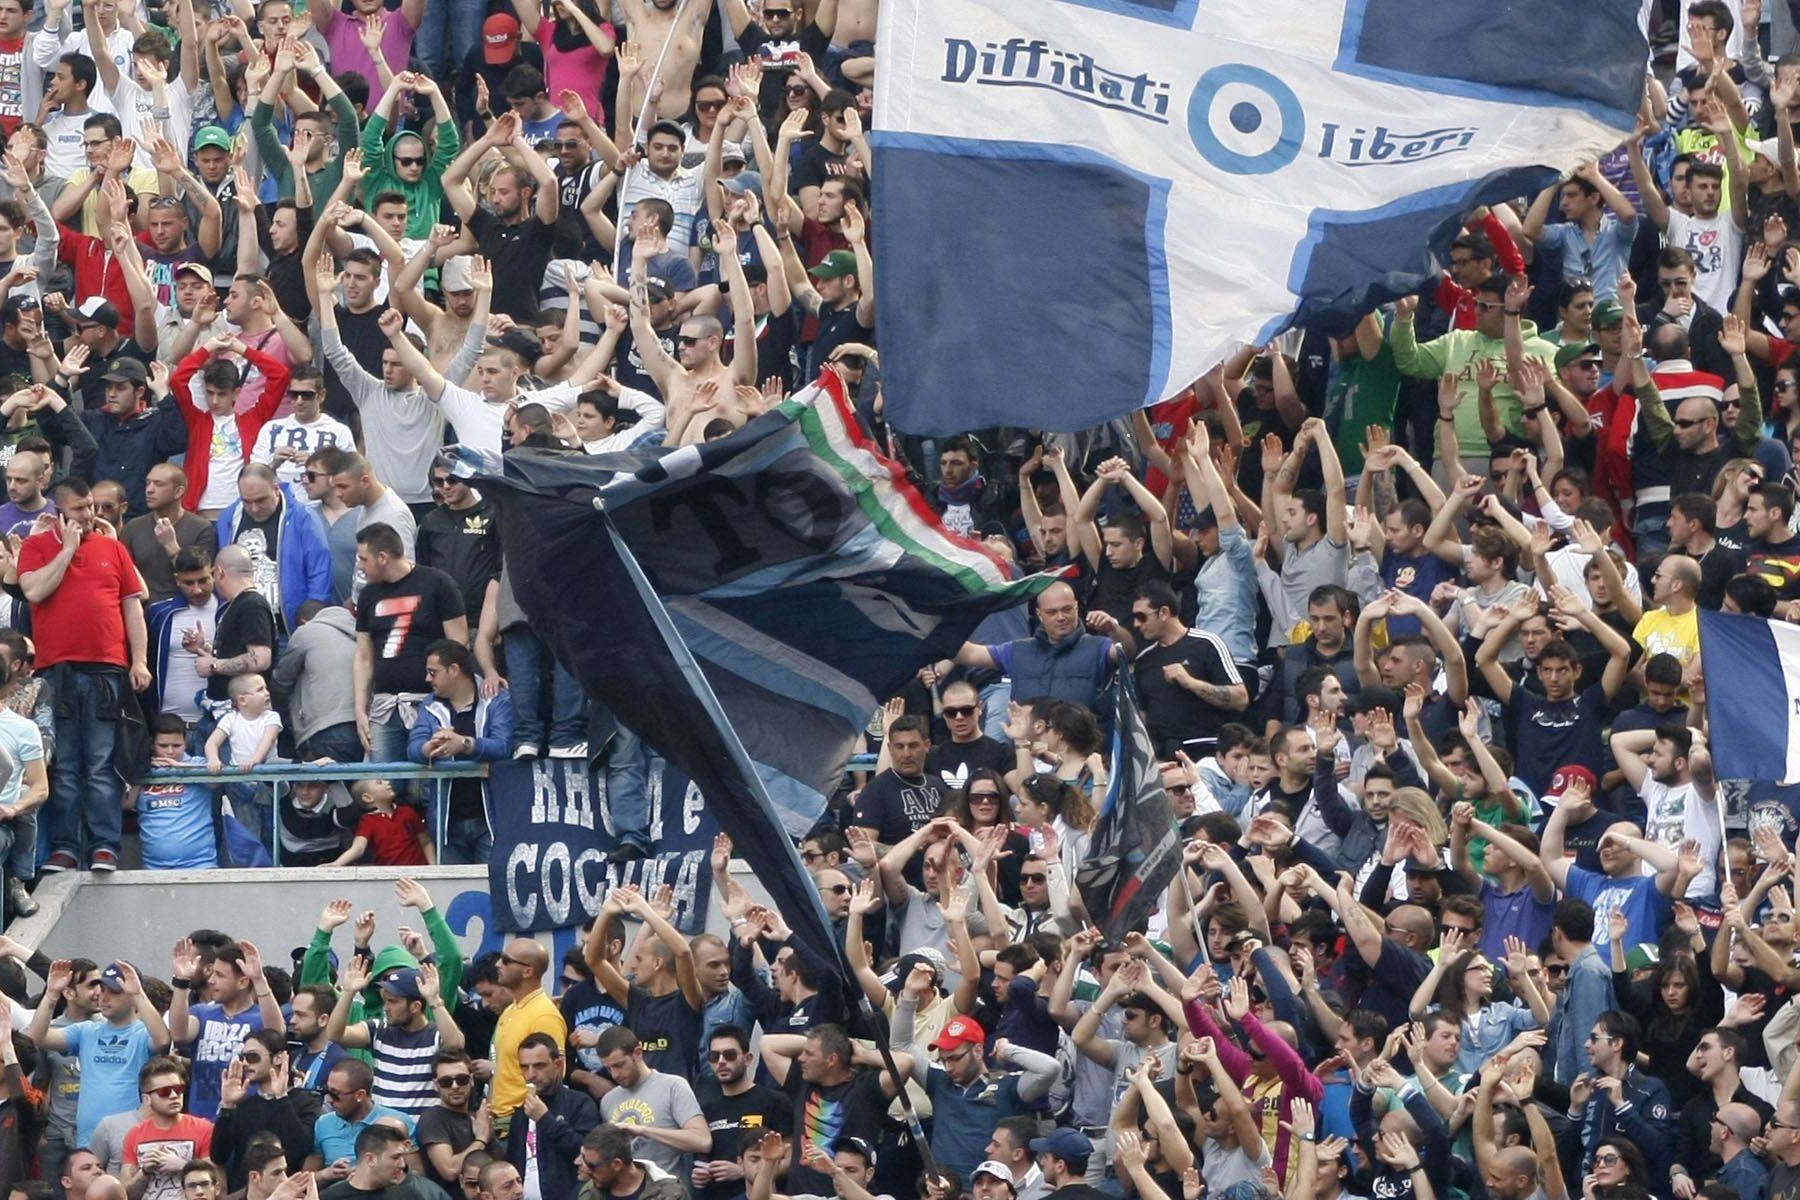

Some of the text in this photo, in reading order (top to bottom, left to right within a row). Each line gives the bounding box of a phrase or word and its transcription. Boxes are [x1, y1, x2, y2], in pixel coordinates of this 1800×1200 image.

[940, 37, 1170, 123] Diffidati
[374, 594, 422, 659] 7
[195, 1039, 245, 1063] ROCK
